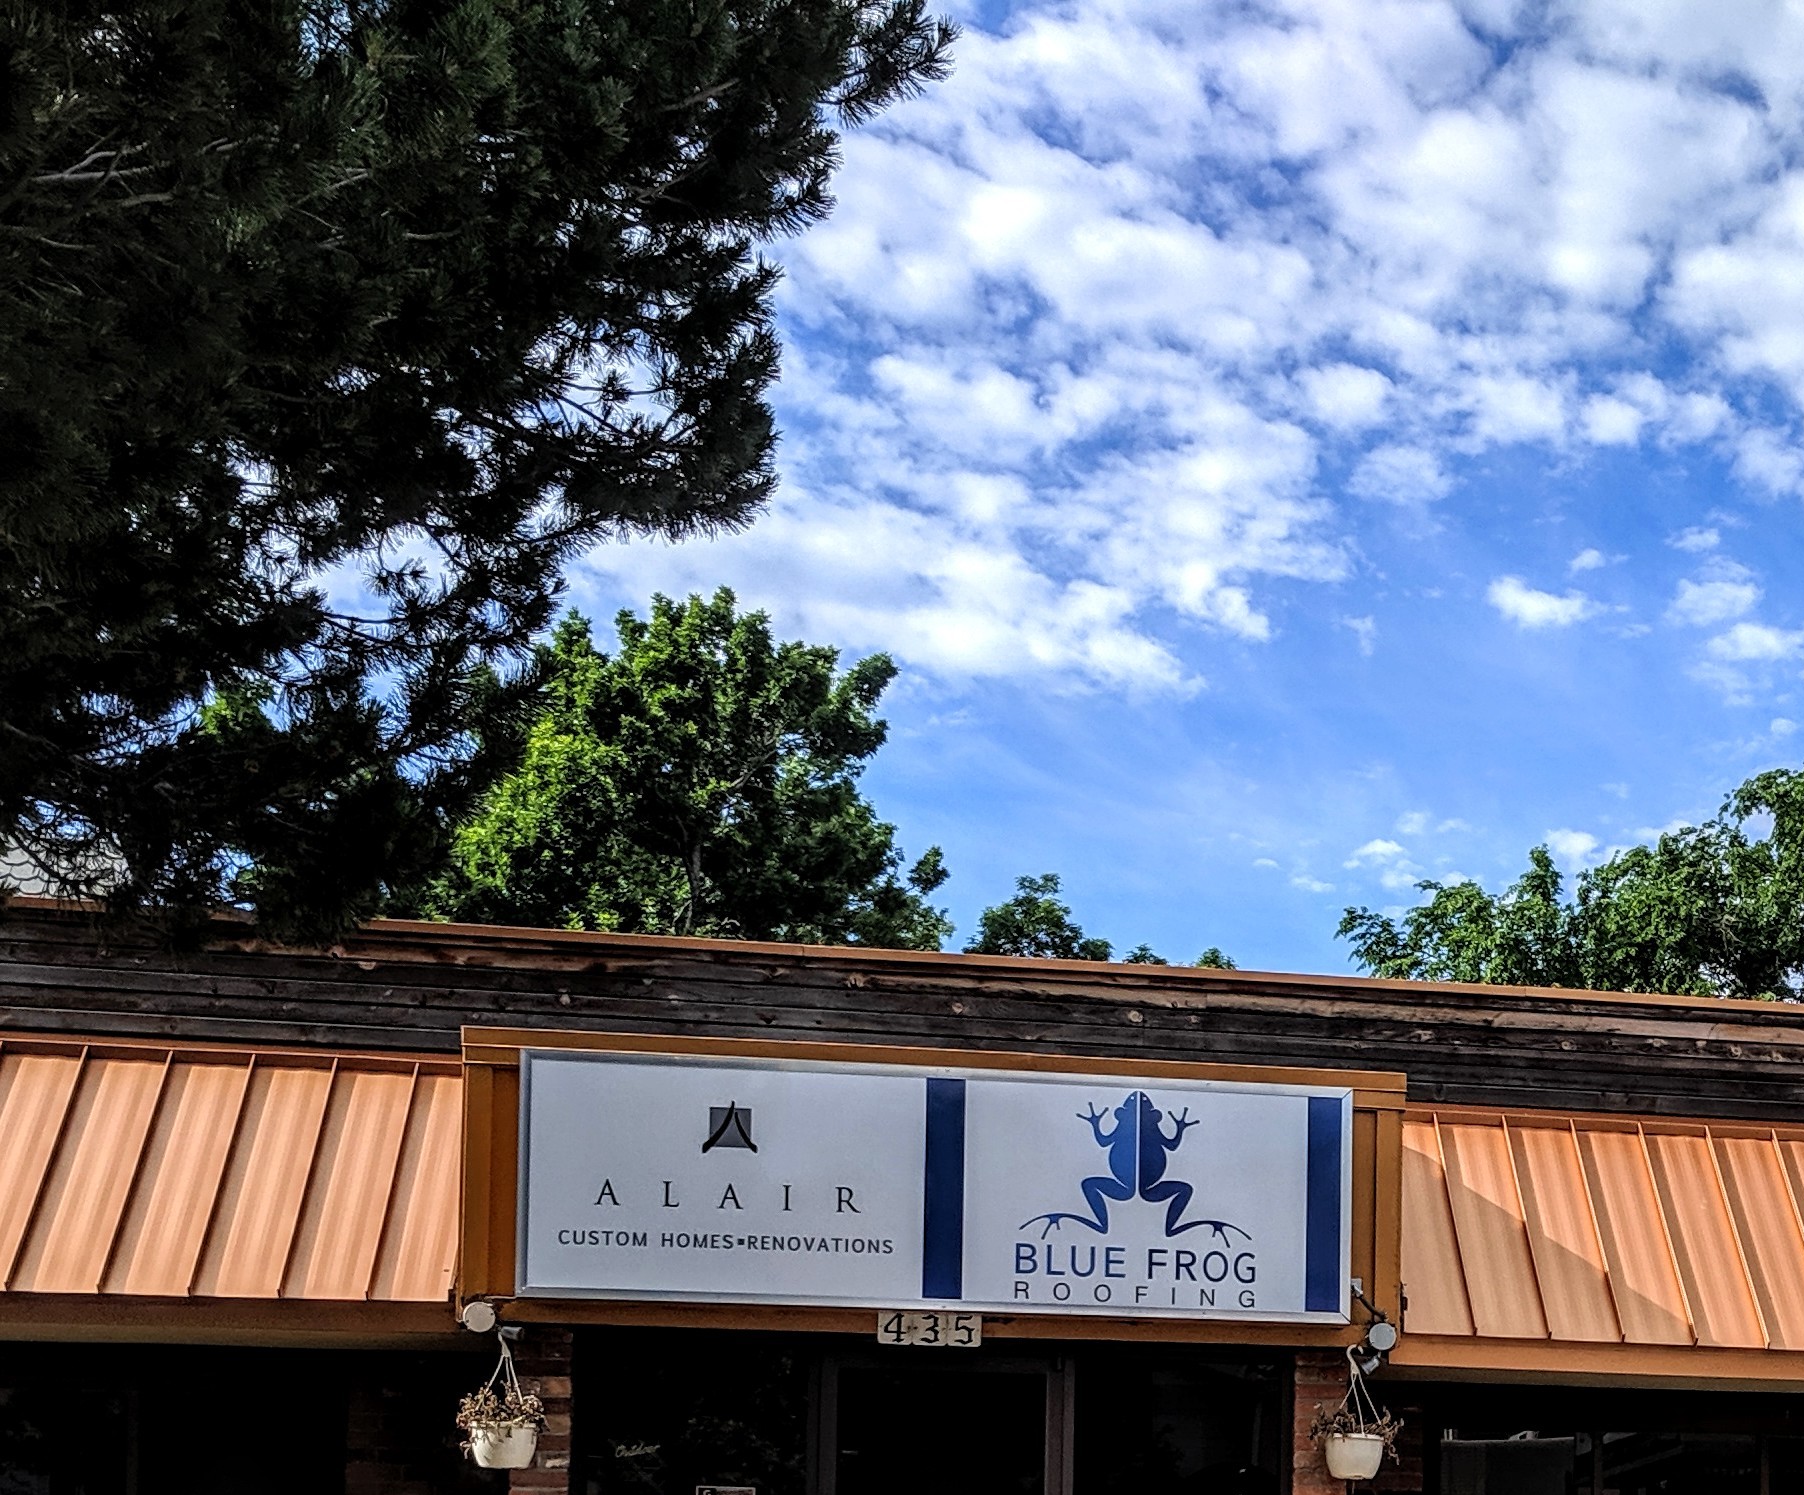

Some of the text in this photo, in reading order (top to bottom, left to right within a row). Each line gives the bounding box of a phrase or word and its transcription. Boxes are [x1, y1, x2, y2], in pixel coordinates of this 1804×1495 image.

[594, 1178, 862, 1214] ALAIR
[558, 1229, 648, 1247] CUSTOM
[1015, 1242, 1256, 1284] BLUE FROG
[1014, 1280, 1256, 1308] ROOFING
[883, 1312, 975, 1345] 435
